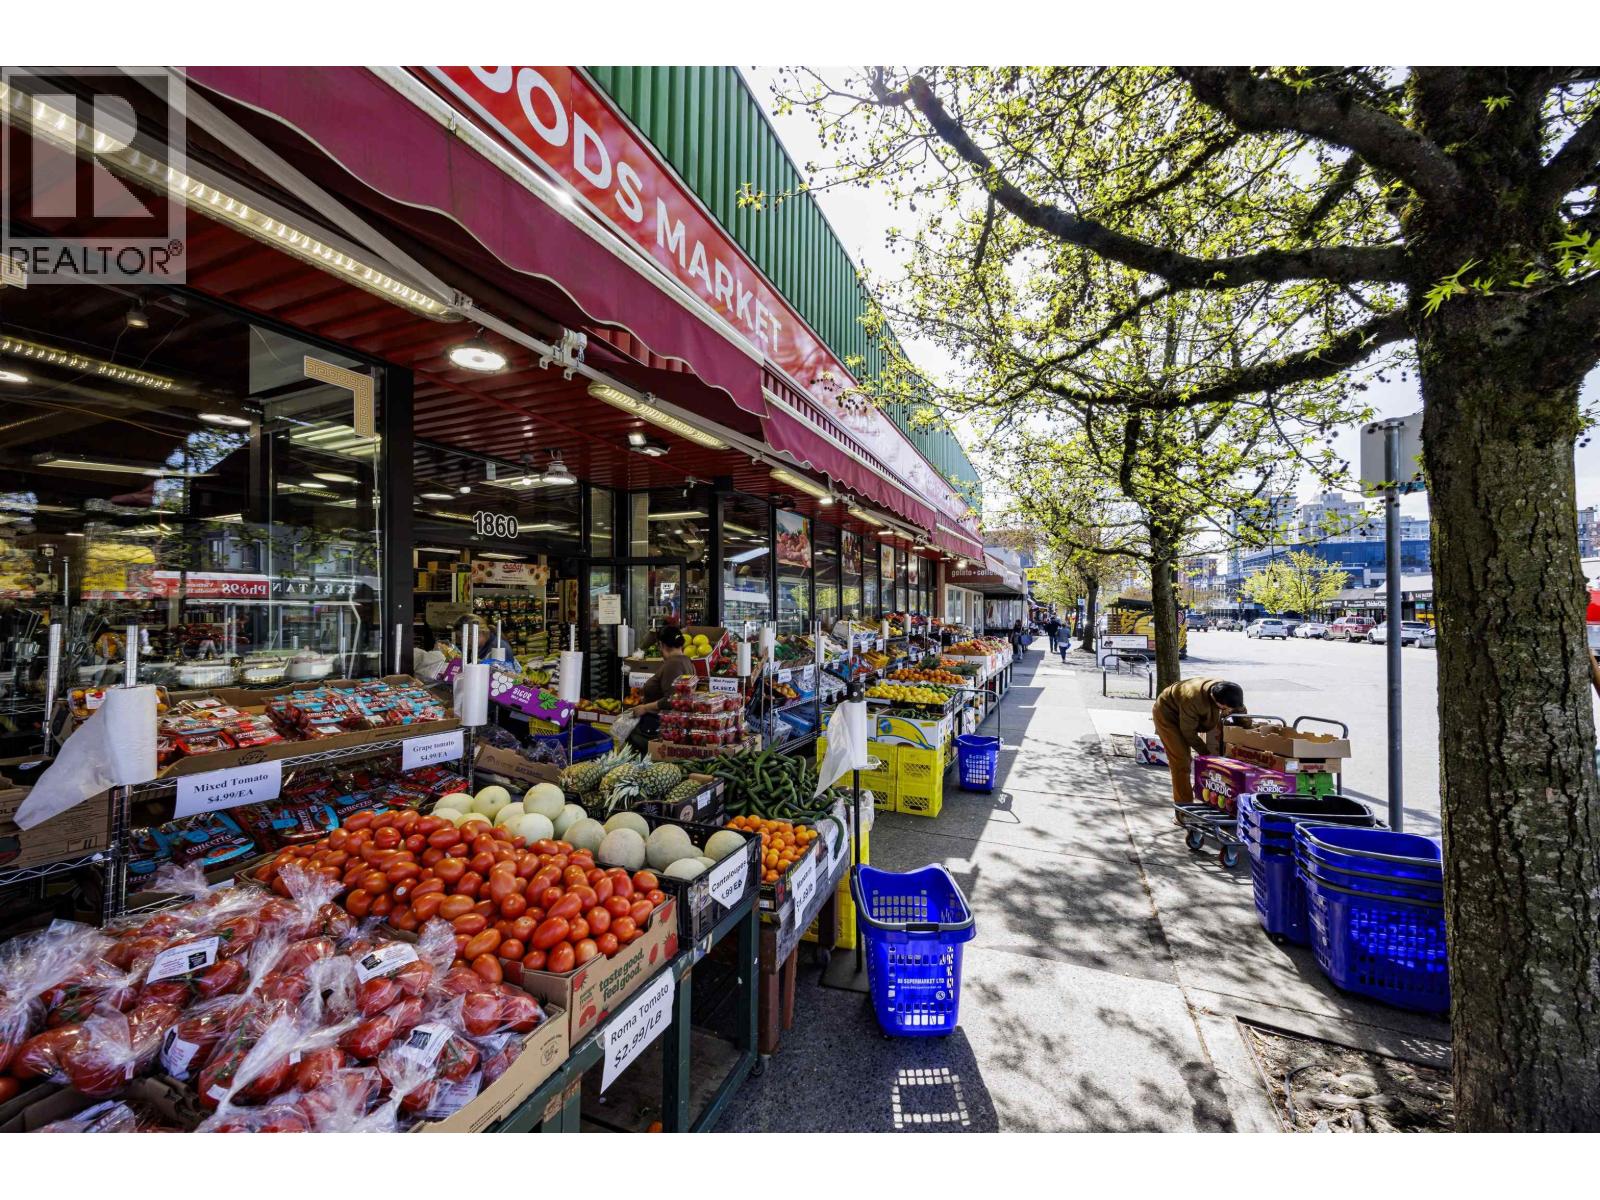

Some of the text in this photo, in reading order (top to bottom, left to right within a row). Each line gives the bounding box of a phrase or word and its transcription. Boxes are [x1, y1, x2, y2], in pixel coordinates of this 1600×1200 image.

[656, 197, 783, 352] MARKET
[473, 511, 518, 538] 1860
[412, 740, 455, 754] Grape tomato
[420, 752, 448, 762] $4.99/EA
[194, 773, 269, 794] Mixed Tomato
[1204, 778, 1233, 799] NORDIC
[1256, 784, 1284, 794] NORDIC
[207, 787, 254, 804] $4.99/EA
[599, 966, 623, 992] taste
[603, 982, 621, 1002] feel
[610, 1014, 638, 1046] Roma
[638, 983, 669, 1018] Tomato
[613, 1009, 662, 1069] $2.99/LB
